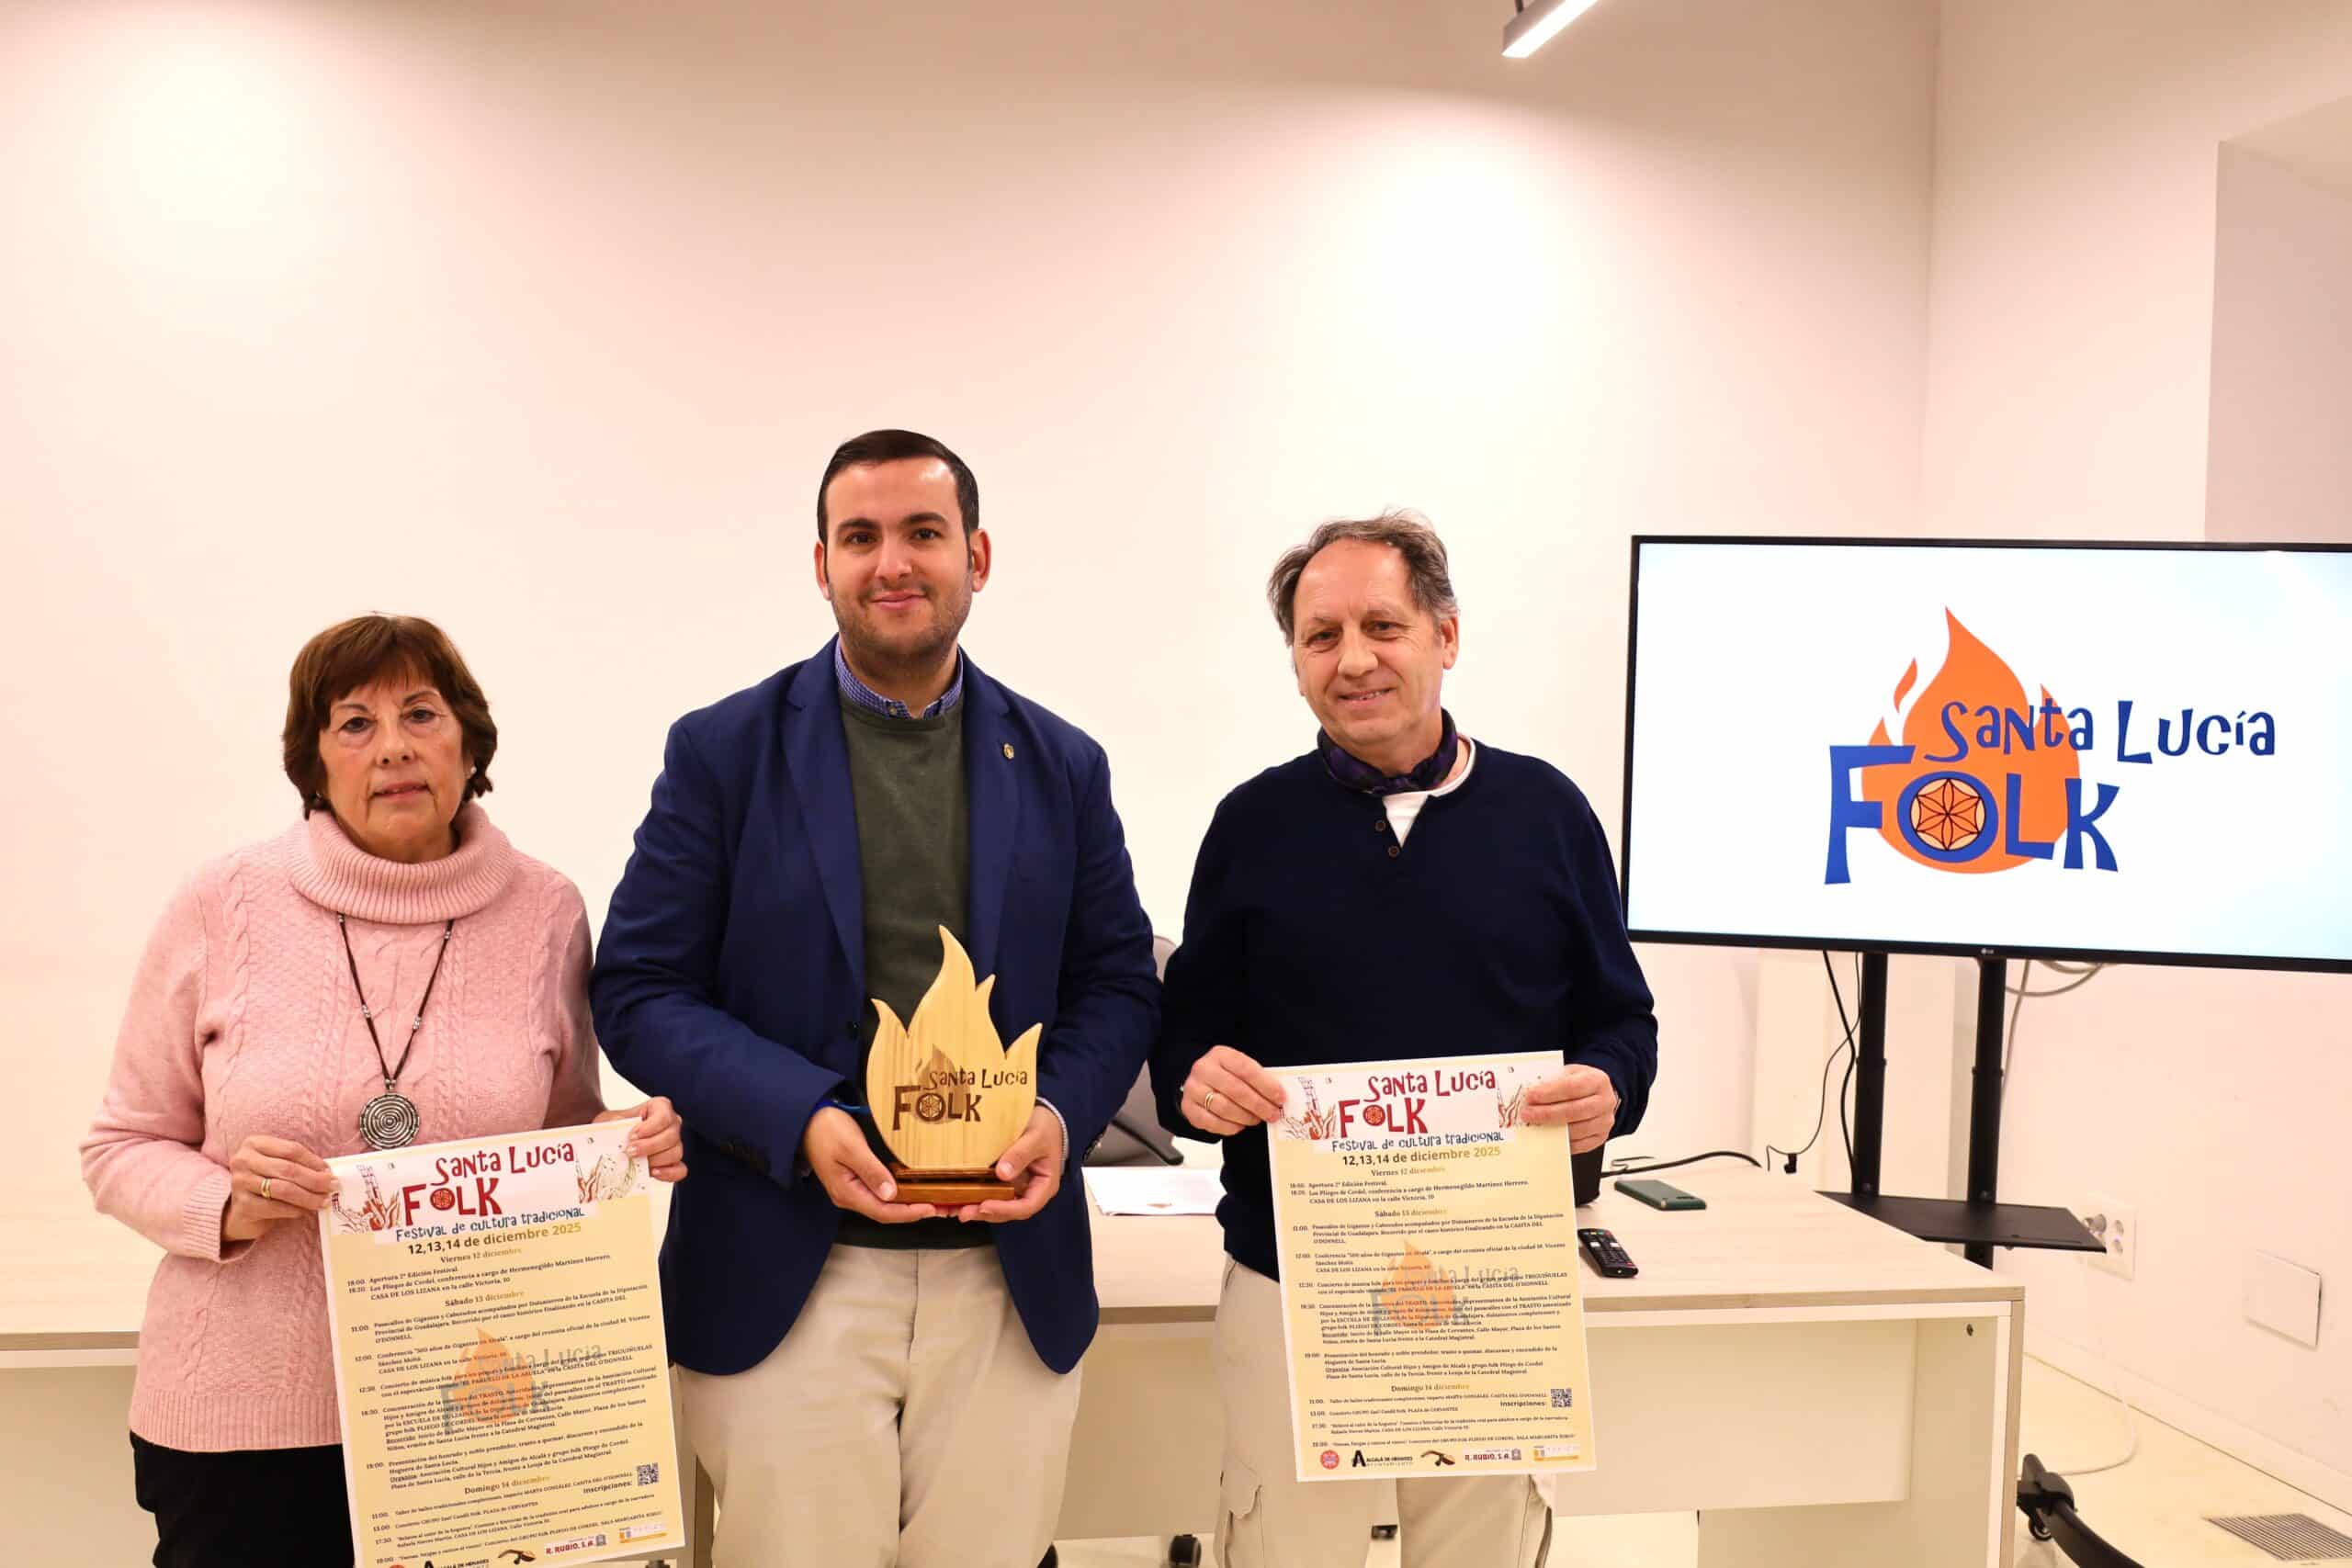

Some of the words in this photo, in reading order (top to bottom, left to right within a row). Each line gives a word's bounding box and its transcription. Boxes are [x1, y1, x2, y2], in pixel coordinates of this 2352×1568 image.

[1923, 697, 2094, 763] Santa
[2117, 700, 2276, 765] Lucía
[1824, 745, 2120, 885] FOLK
[923, 1066, 976, 1090] Santa
[981, 1068, 1028, 1089] Lucía
[1363, 1071, 1426, 1102] Santa
[1435, 1069, 1496, 1097] Lucía
[892, 1085, 982, 1131] FOLK
[1338, 1097, 1429, 1138] FOLK
[1381, 1137, 1394, 1149] de
[1393, 1152, 1407, 1163] de
[1410, 1148, 1470, 1162] diciembre
[1474, 1145, 1500, 1157] 2025
[430, 1150, 501, 1186] Santa
[509, 1143, 574, 1174] Lucía
[1371, 1168, 1398, 1177] Viernes
[401, 1178, 503, 1226] FOLK
[452, 1223, 466, 1235] de
[464, 1235, 480, 1247] de
[483, 1226, 549, 1245] diciembre
[552, 1222, 582, 1235] 2025
[440, 1255, 470, 1265] Viernes
[445, 1297, 473, 1307] Sábado
[1391, 1383, 1423, 1393] Domingo
[464, 1483, 500, 1495] Domingo
